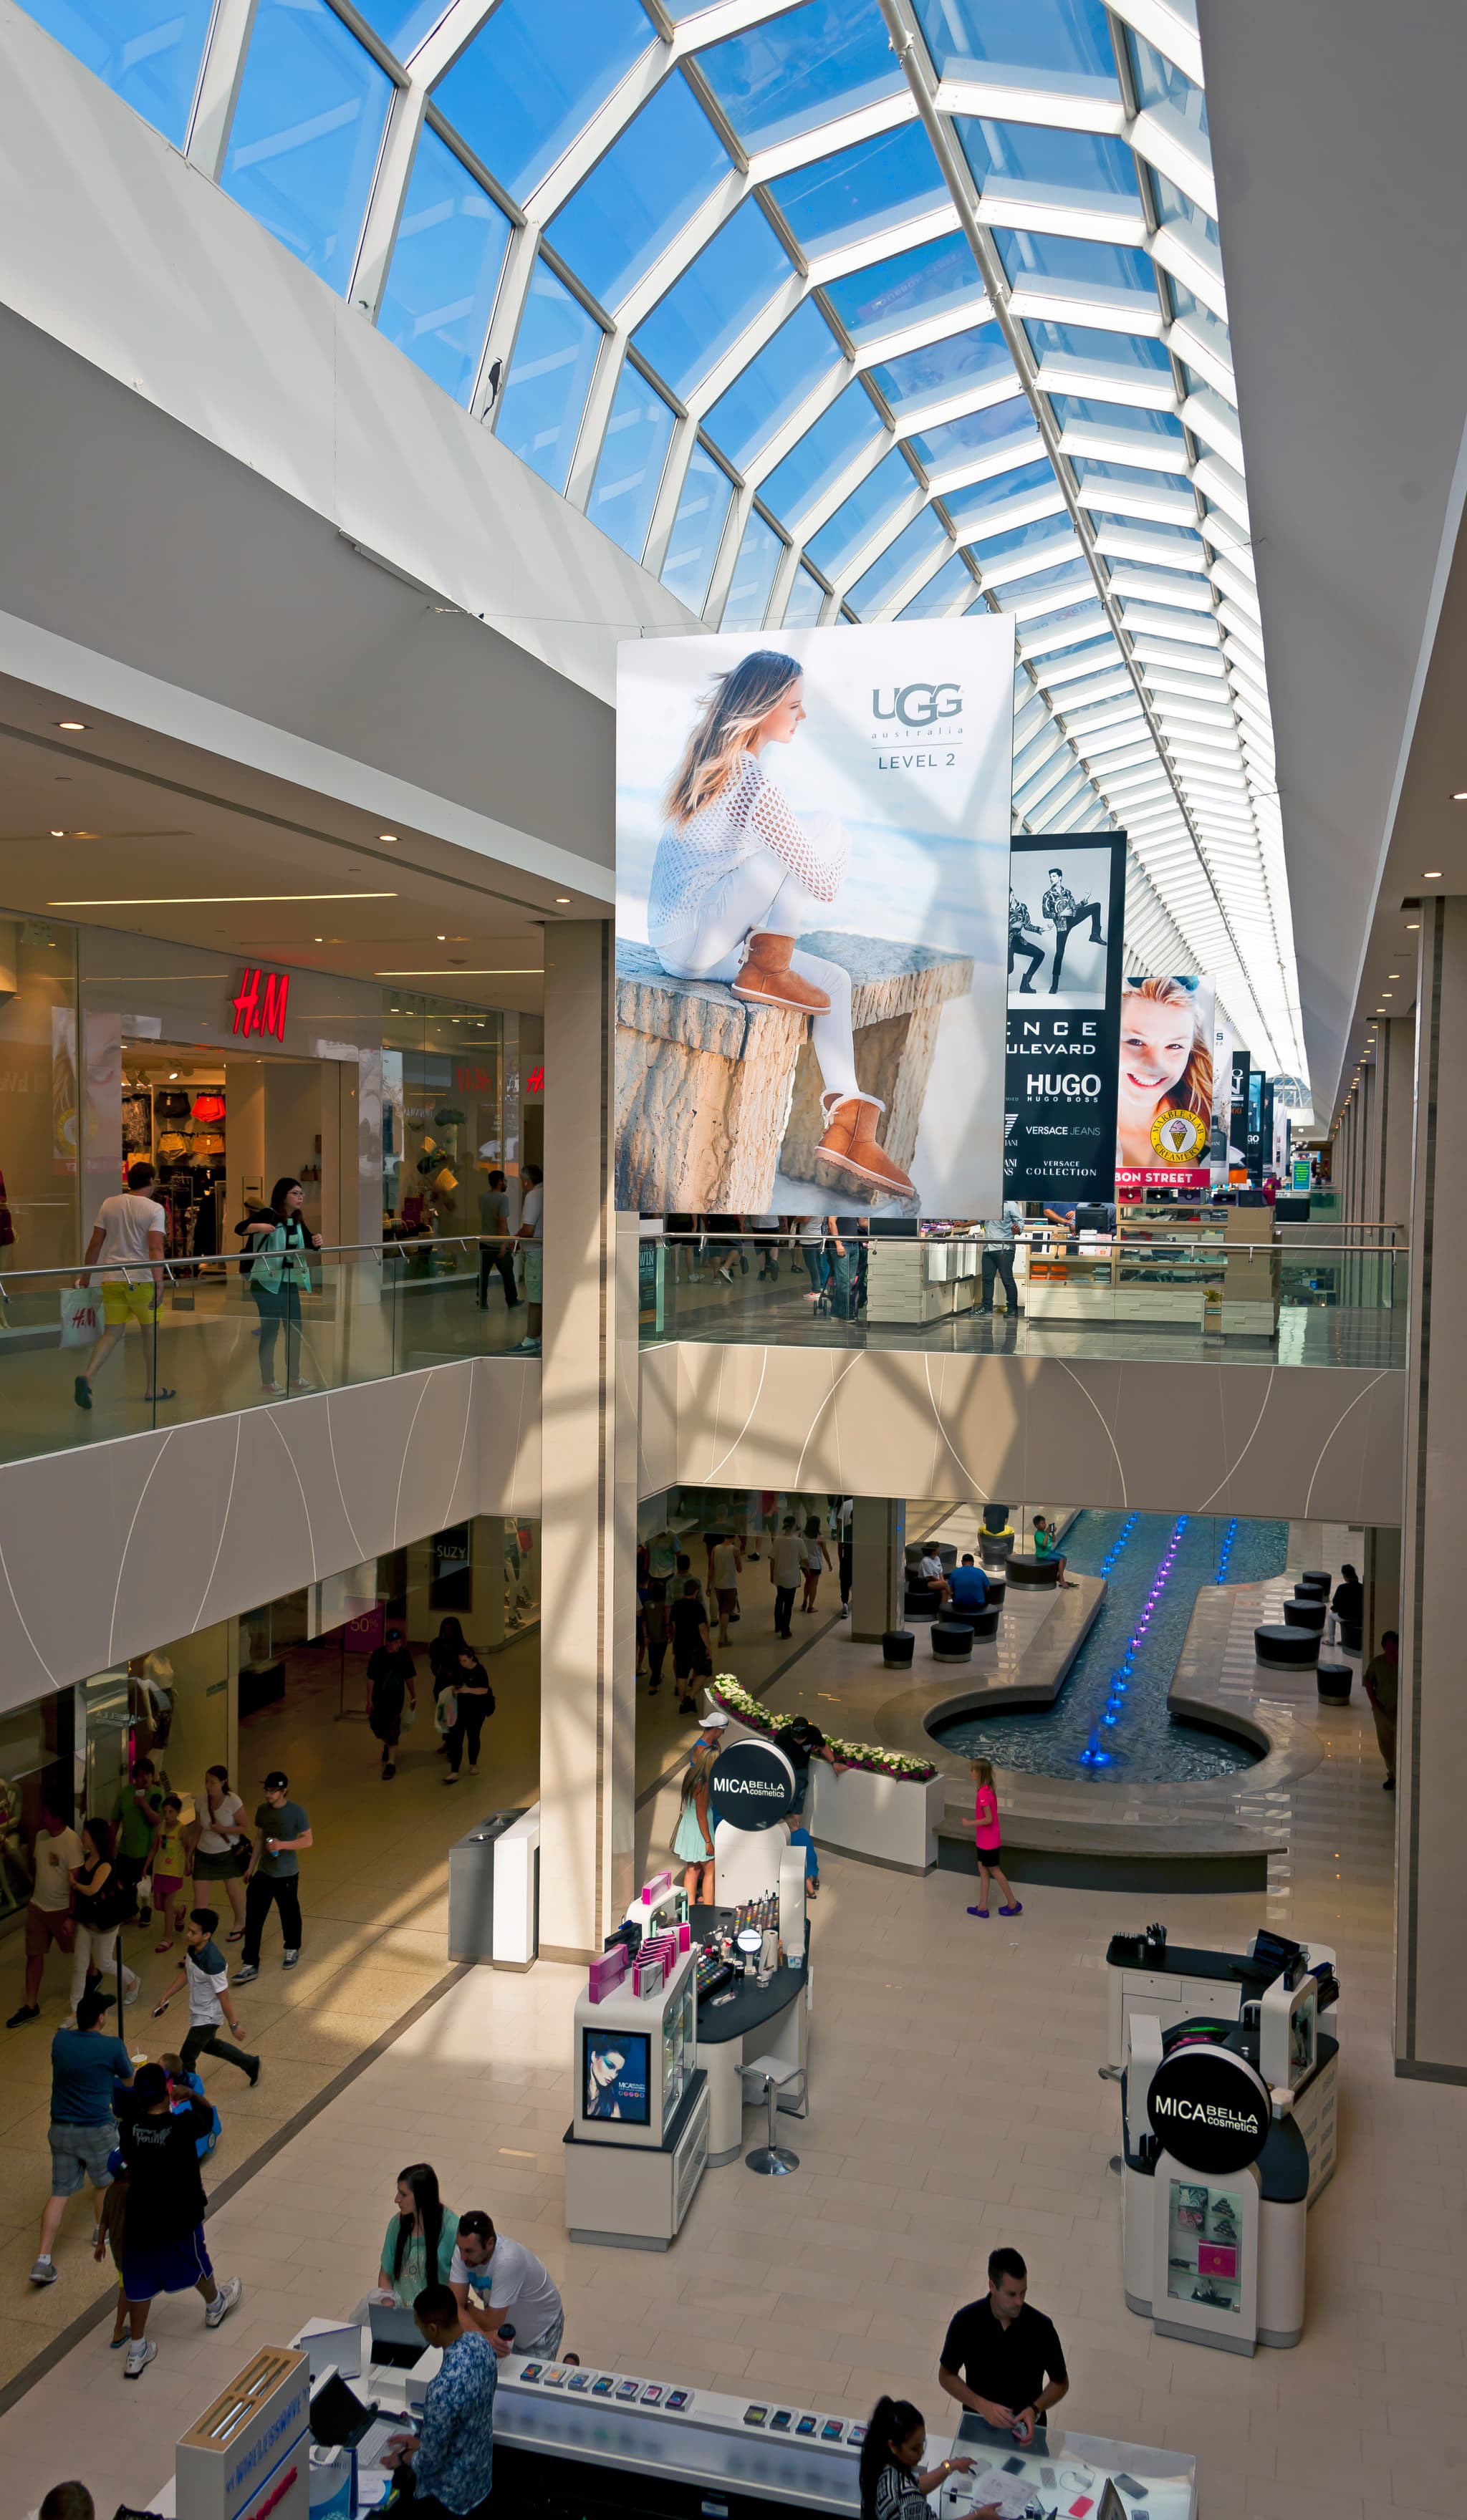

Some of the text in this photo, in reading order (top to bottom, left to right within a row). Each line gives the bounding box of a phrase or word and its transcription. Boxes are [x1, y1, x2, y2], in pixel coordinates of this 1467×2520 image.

[872, 683, 963, 728] UGG
[872, 726, 963, 739] australia
[879, 753, 955, 769] LEVEL 2
[233, 967, 289, 1043] H&M
[1026, 1073, 1102, 1096] HUGO
[1153, 1110, 1204, 1134] MARBLE SLAB
[1026, 1126, 1101, 1136] VERSACE JEANS
[1155, 1143, 1201, 1161] CREAMERY
[1145, 1173, 1193, 1183] STREET
[436, 1545, 466, 1559] SUZY
[750, 1789, 785, 1797] cosmetics
[1208, 2117, 1258, 2134] cosmetics
